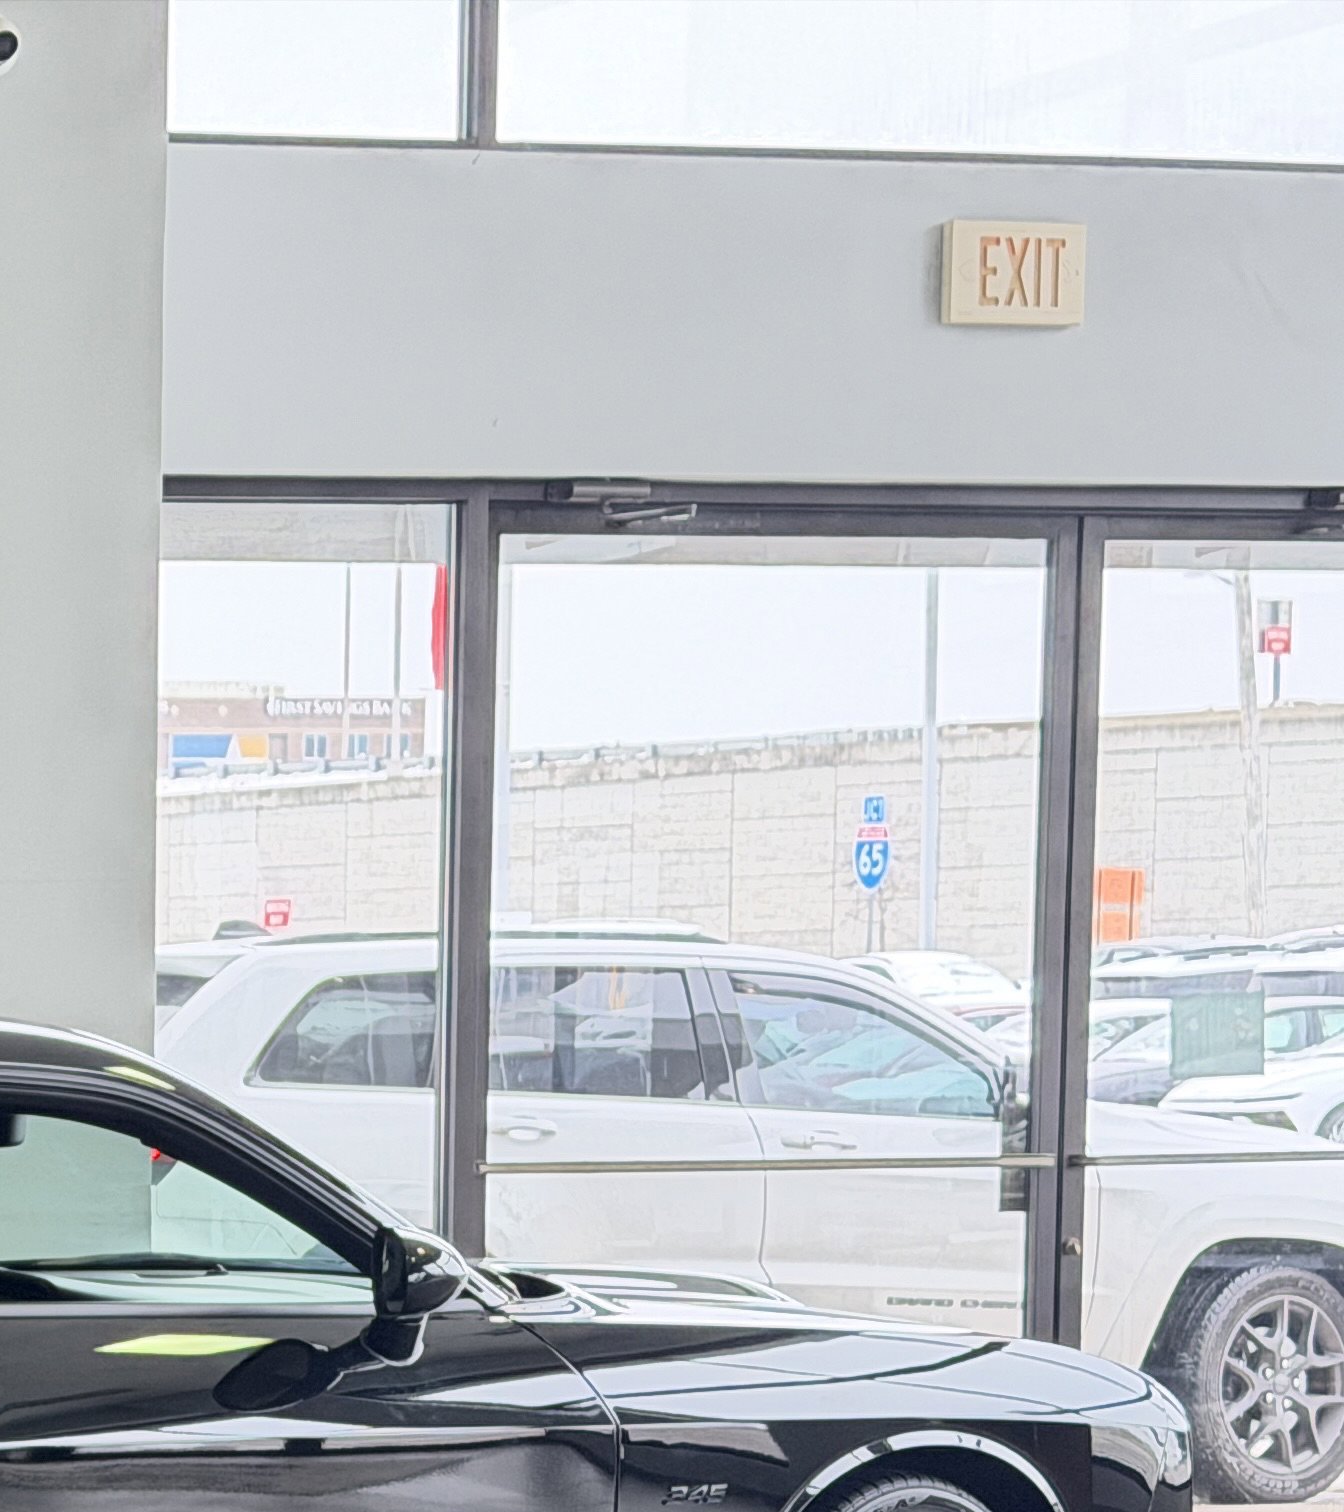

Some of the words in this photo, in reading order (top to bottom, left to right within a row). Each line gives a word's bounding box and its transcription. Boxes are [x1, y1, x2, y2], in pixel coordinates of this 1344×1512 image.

[978, 235, 1066, 308] EXIT
[372, 699, 411, 716] BAK
[858, 842, 884, 876] 65
